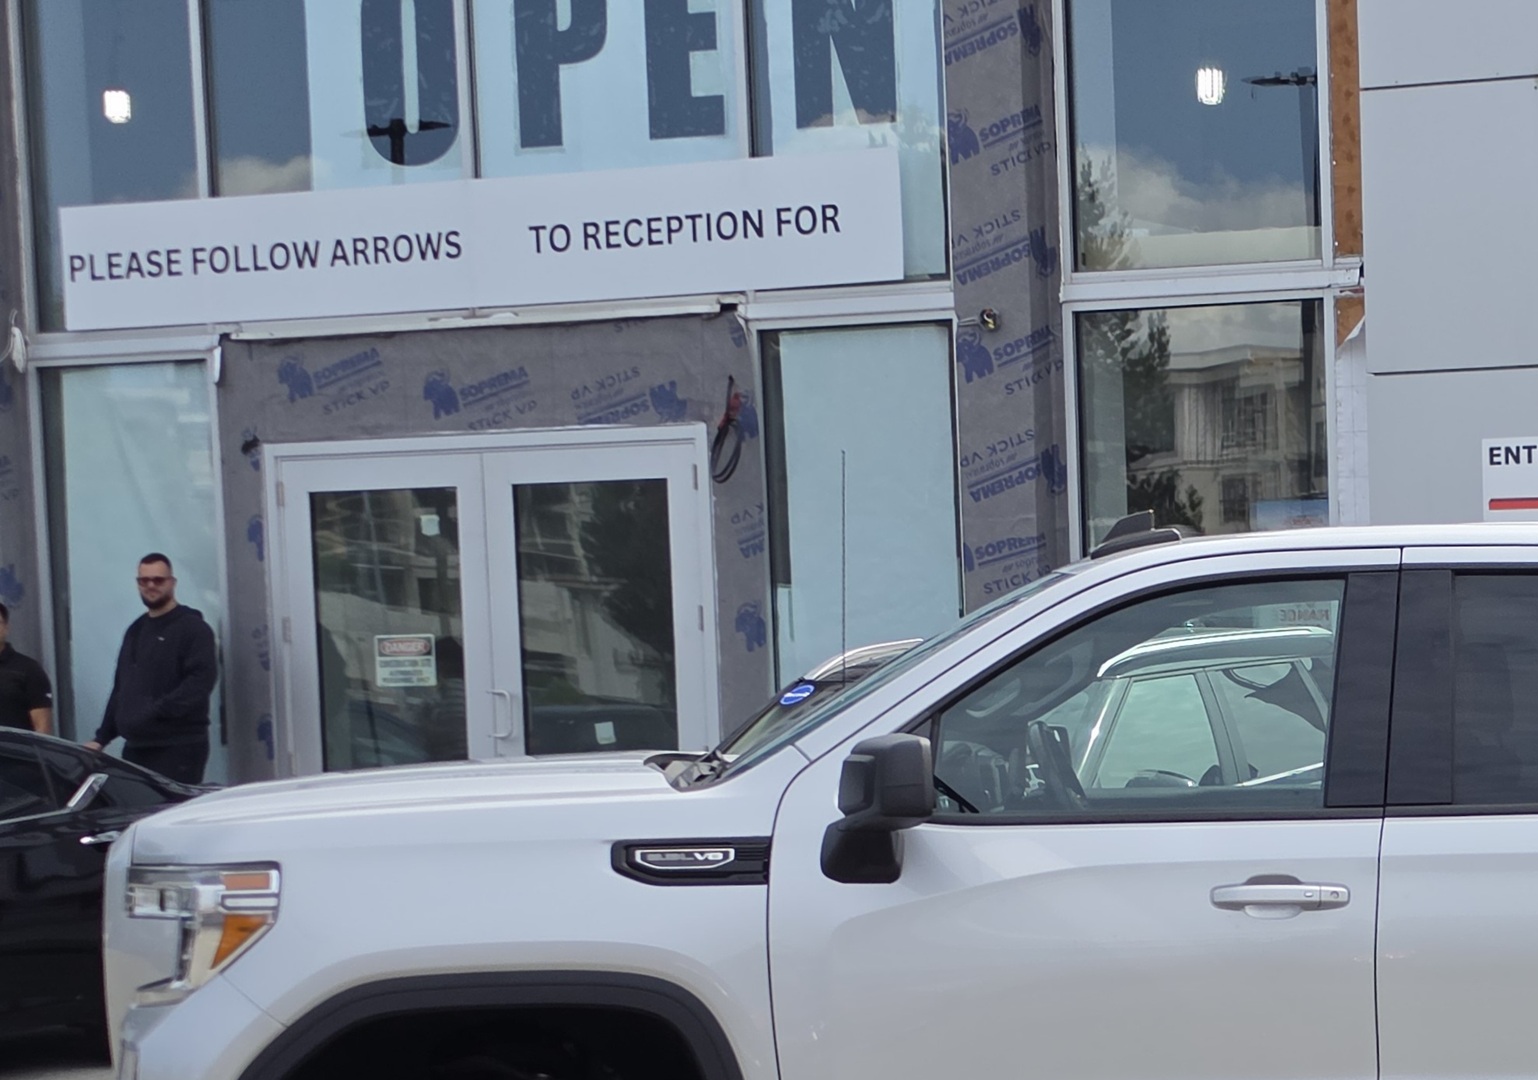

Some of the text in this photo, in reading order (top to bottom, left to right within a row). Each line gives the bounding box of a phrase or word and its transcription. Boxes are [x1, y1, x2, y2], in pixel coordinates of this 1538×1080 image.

[361, 0, 897, 166] OPEN
[69, 204, 841, 282] PLEASE FOLLOW ARROWS TO RECEPTION FOR
